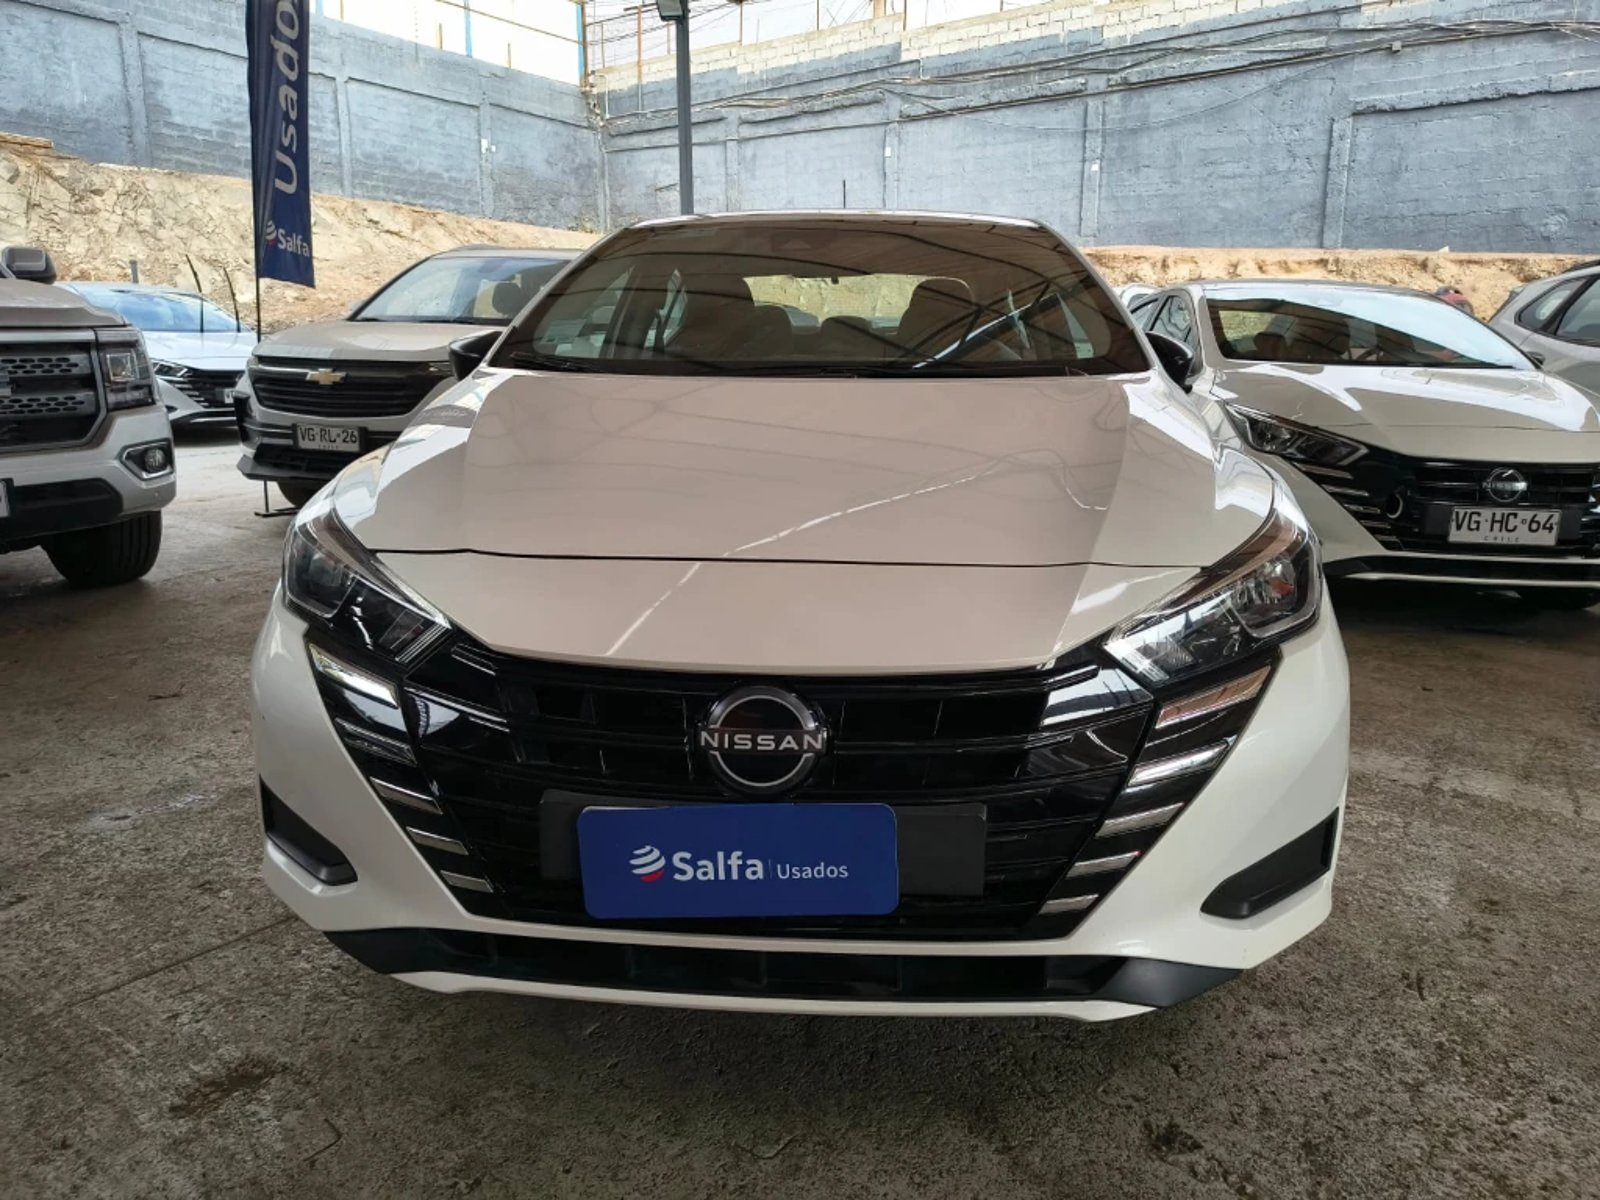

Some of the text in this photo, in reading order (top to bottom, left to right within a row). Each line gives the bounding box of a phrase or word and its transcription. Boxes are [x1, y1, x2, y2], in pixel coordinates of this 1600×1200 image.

[270, 0, 299, 195] Usado
[277, 228, 310, 257] Salfa
[700, 730, 823, 750] NISSAN
[671, 850, 849, 882] Salfa Usados
